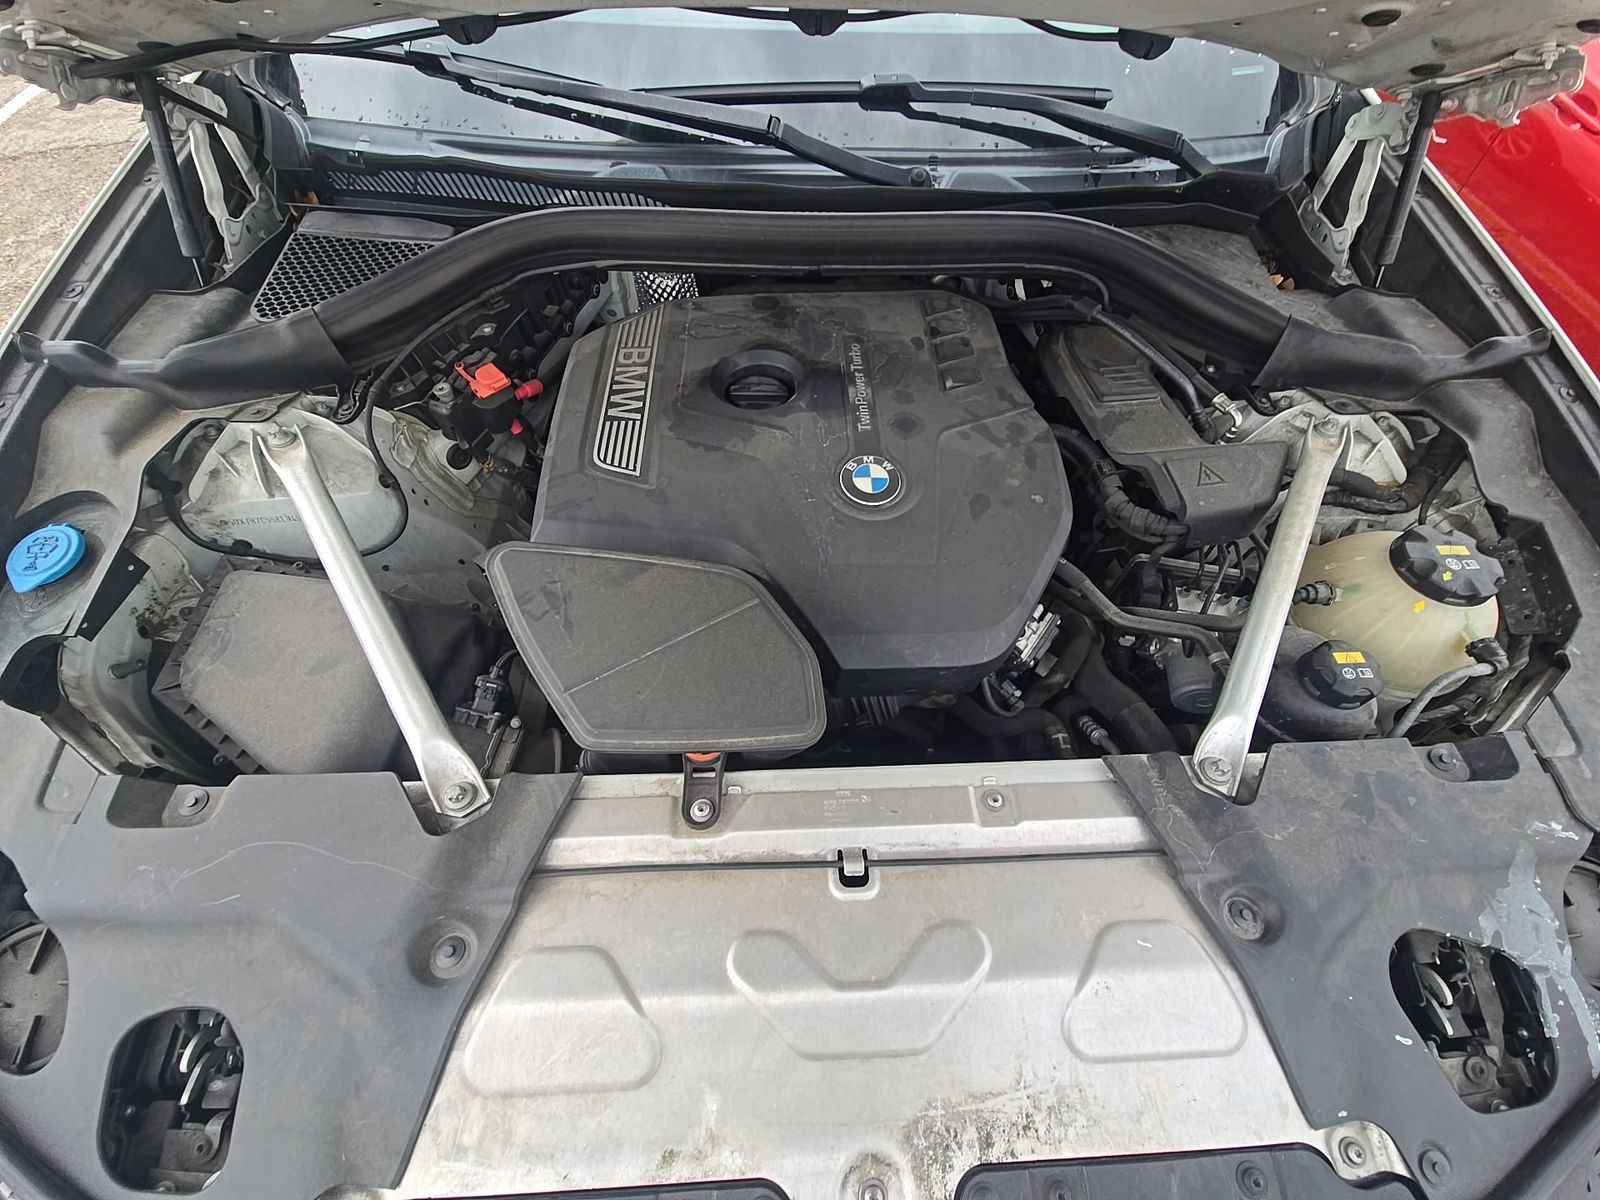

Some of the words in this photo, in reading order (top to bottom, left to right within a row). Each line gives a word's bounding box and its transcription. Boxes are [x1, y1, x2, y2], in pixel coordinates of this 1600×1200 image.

[848, 343, 863, 371] Turbo
[607, 347, 651, 420] BMW
[854, 371, 871, 432] TwinPower
[846, 455, 894, 471] BMW
